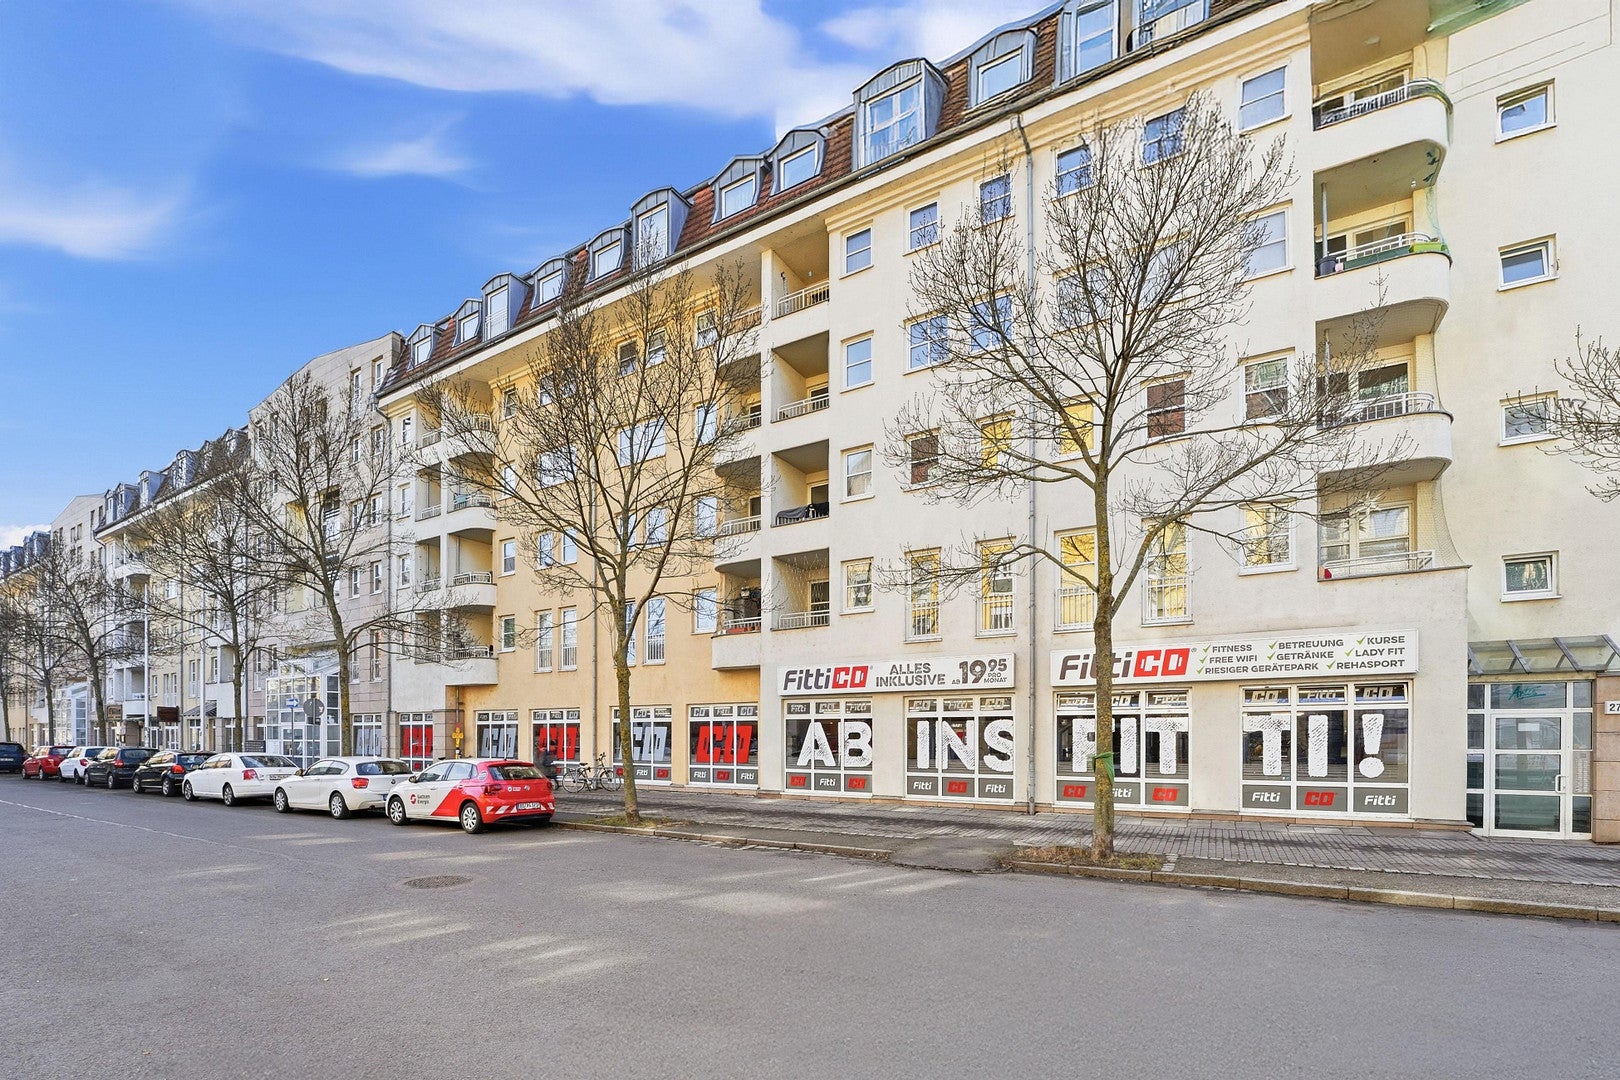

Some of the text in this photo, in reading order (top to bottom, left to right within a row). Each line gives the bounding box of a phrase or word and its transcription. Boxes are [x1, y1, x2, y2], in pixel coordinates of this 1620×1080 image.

[1278, 640, 1344, 650] BETREUUNG
[1367, 636, 1405, 645] KURSE
[1212, 645, 1252, 653] FITNESS
[1355, 647, 1405, 657] LADY FIT
[1209, 656, 1233, 664] FREE
[1276, 651, 1334, 661] GETRÄNKE
[890, 663, 931, 675] ALLES
[1205, 662, 1319, 675] RIESIGER GERÄTEPARK
[1336, 660, 1405, 669] REHASPORT
[876, 674, 946, 687] INKLUSIVE
[796, 721, 872, 767] AB
[917, 719, 1014, 771] INS
[819, 778, 835, 786] Fitti
[913, 782, 932, 790] Fitti
[985, 784, 1006, 793] Fitti
[1251, 792, 1280, 802] Fitti
[1364, 795, 1396, 806] Fitti
